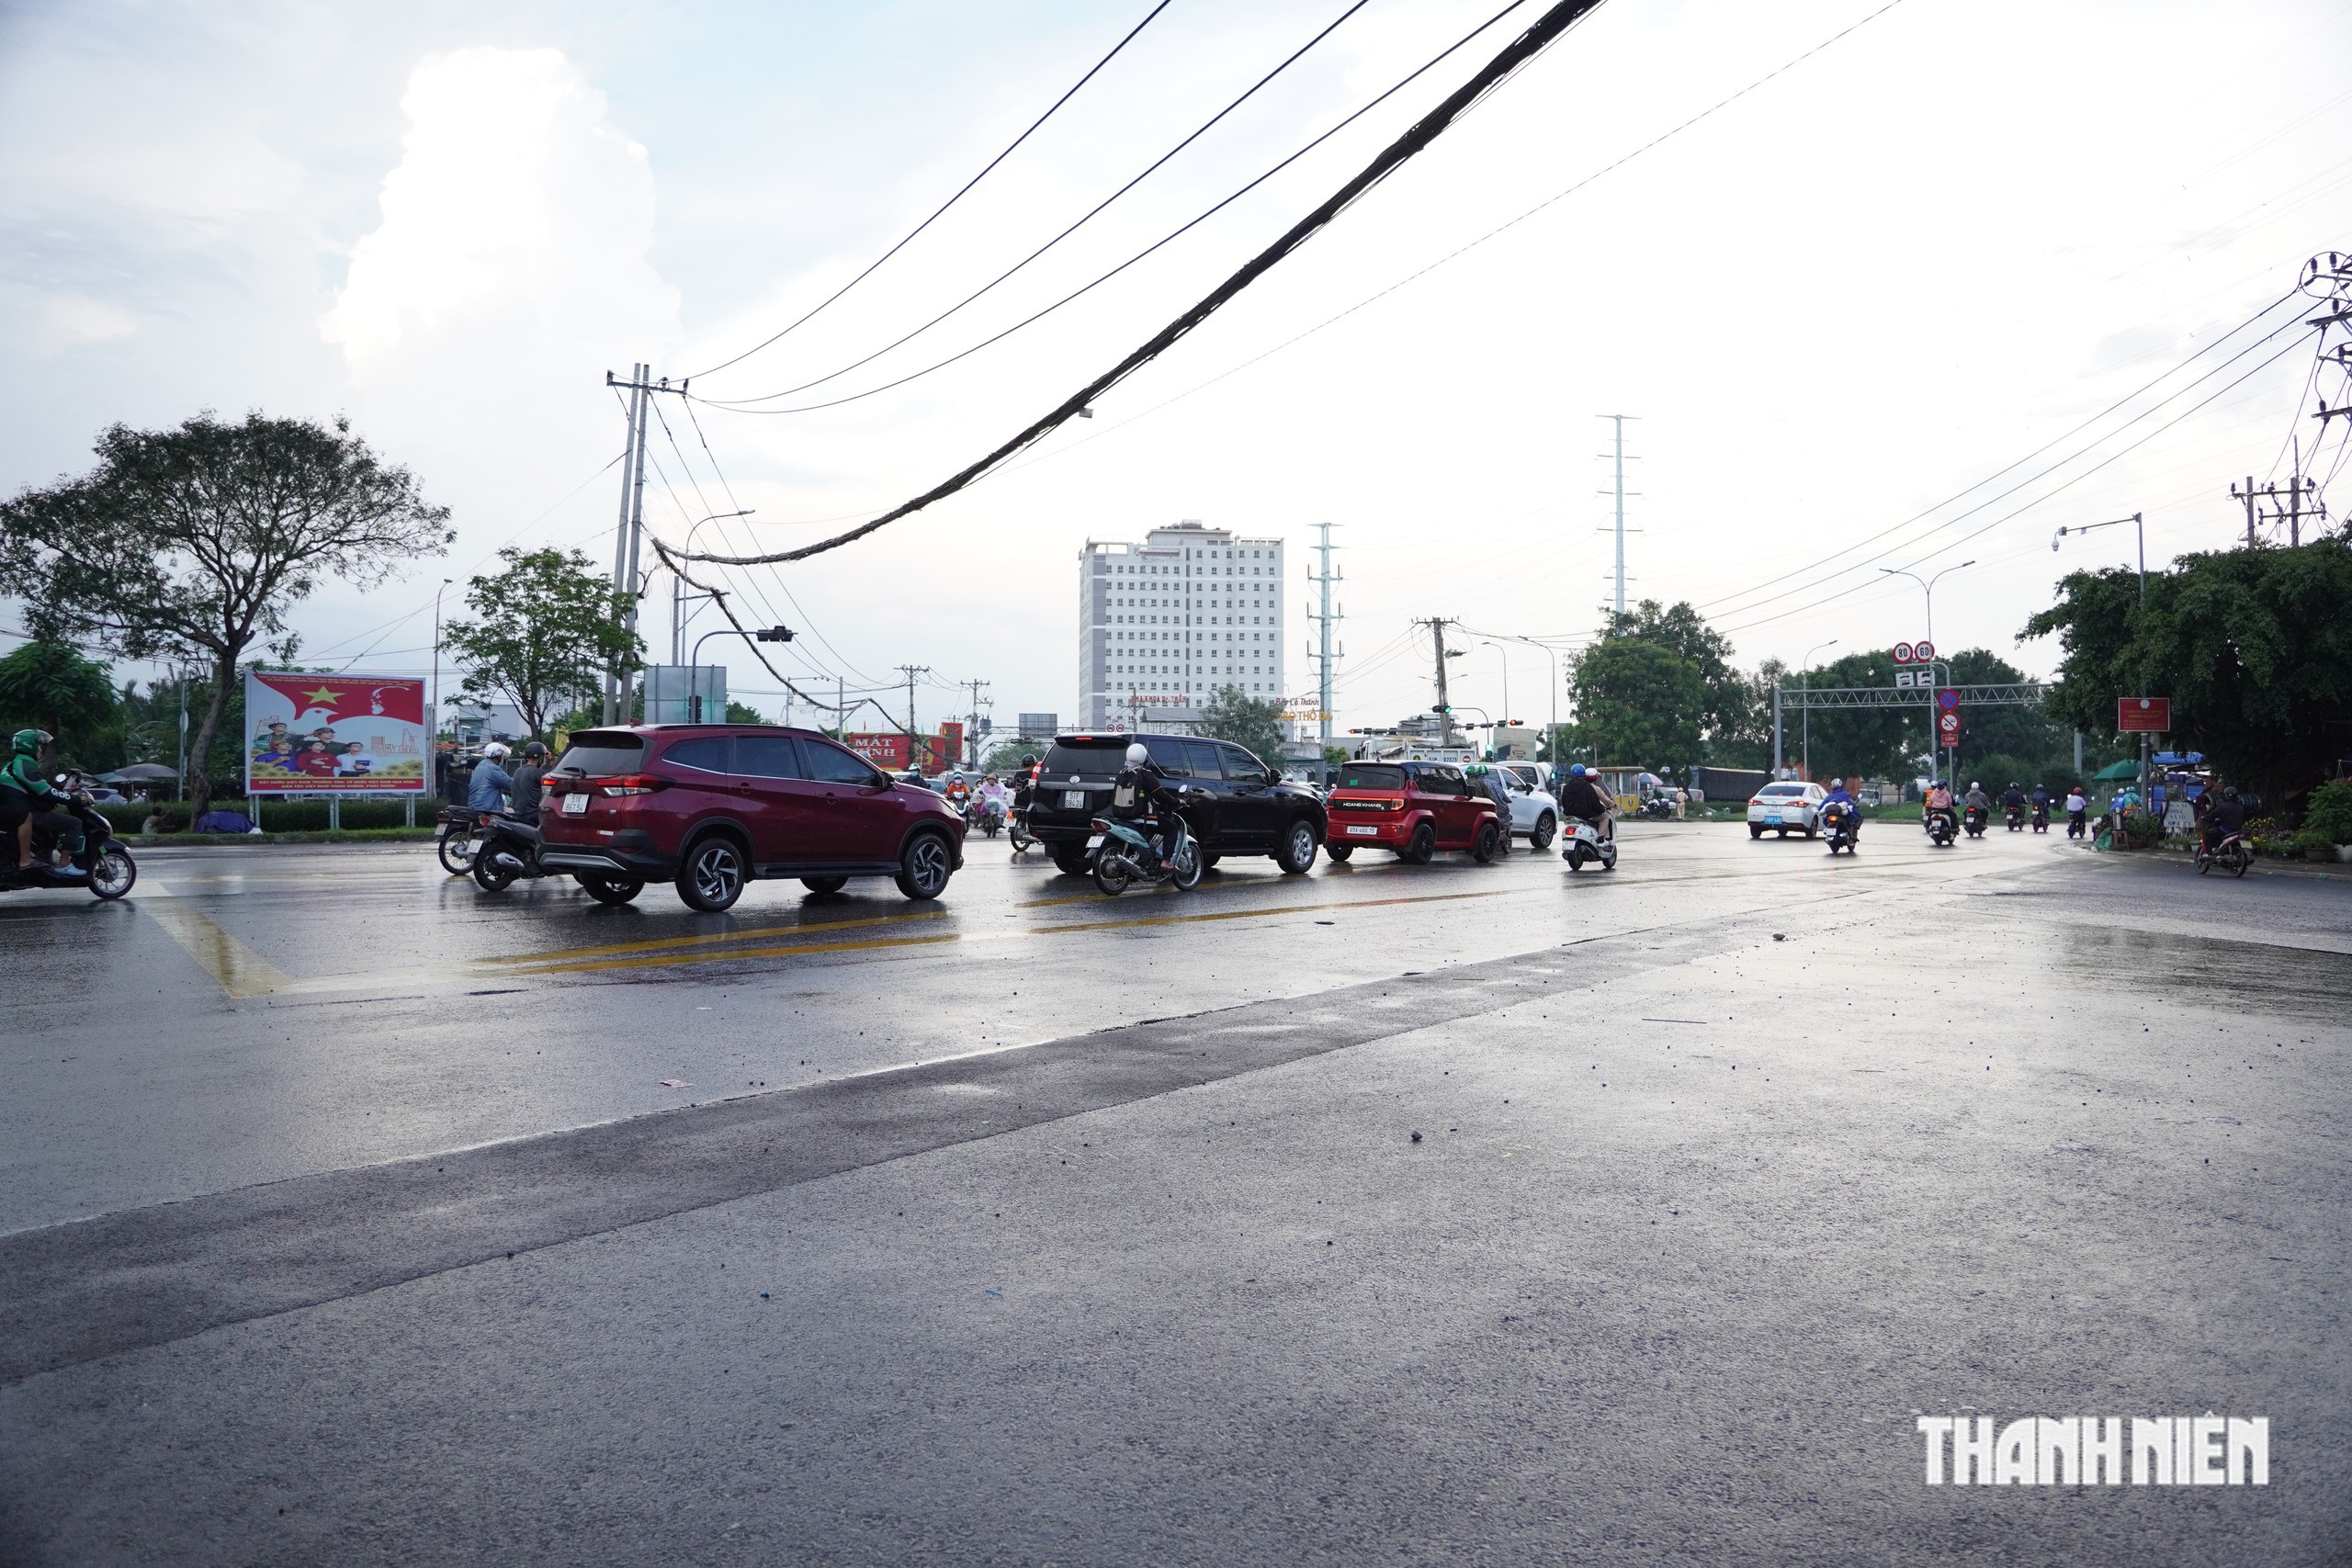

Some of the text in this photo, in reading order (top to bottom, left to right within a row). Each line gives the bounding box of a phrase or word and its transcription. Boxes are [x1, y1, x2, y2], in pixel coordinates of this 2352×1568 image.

[1898, 648, 1908, 658] 80
[1919, 647, 1929, 657] 60
[51, 787, 71, 800] Grab
